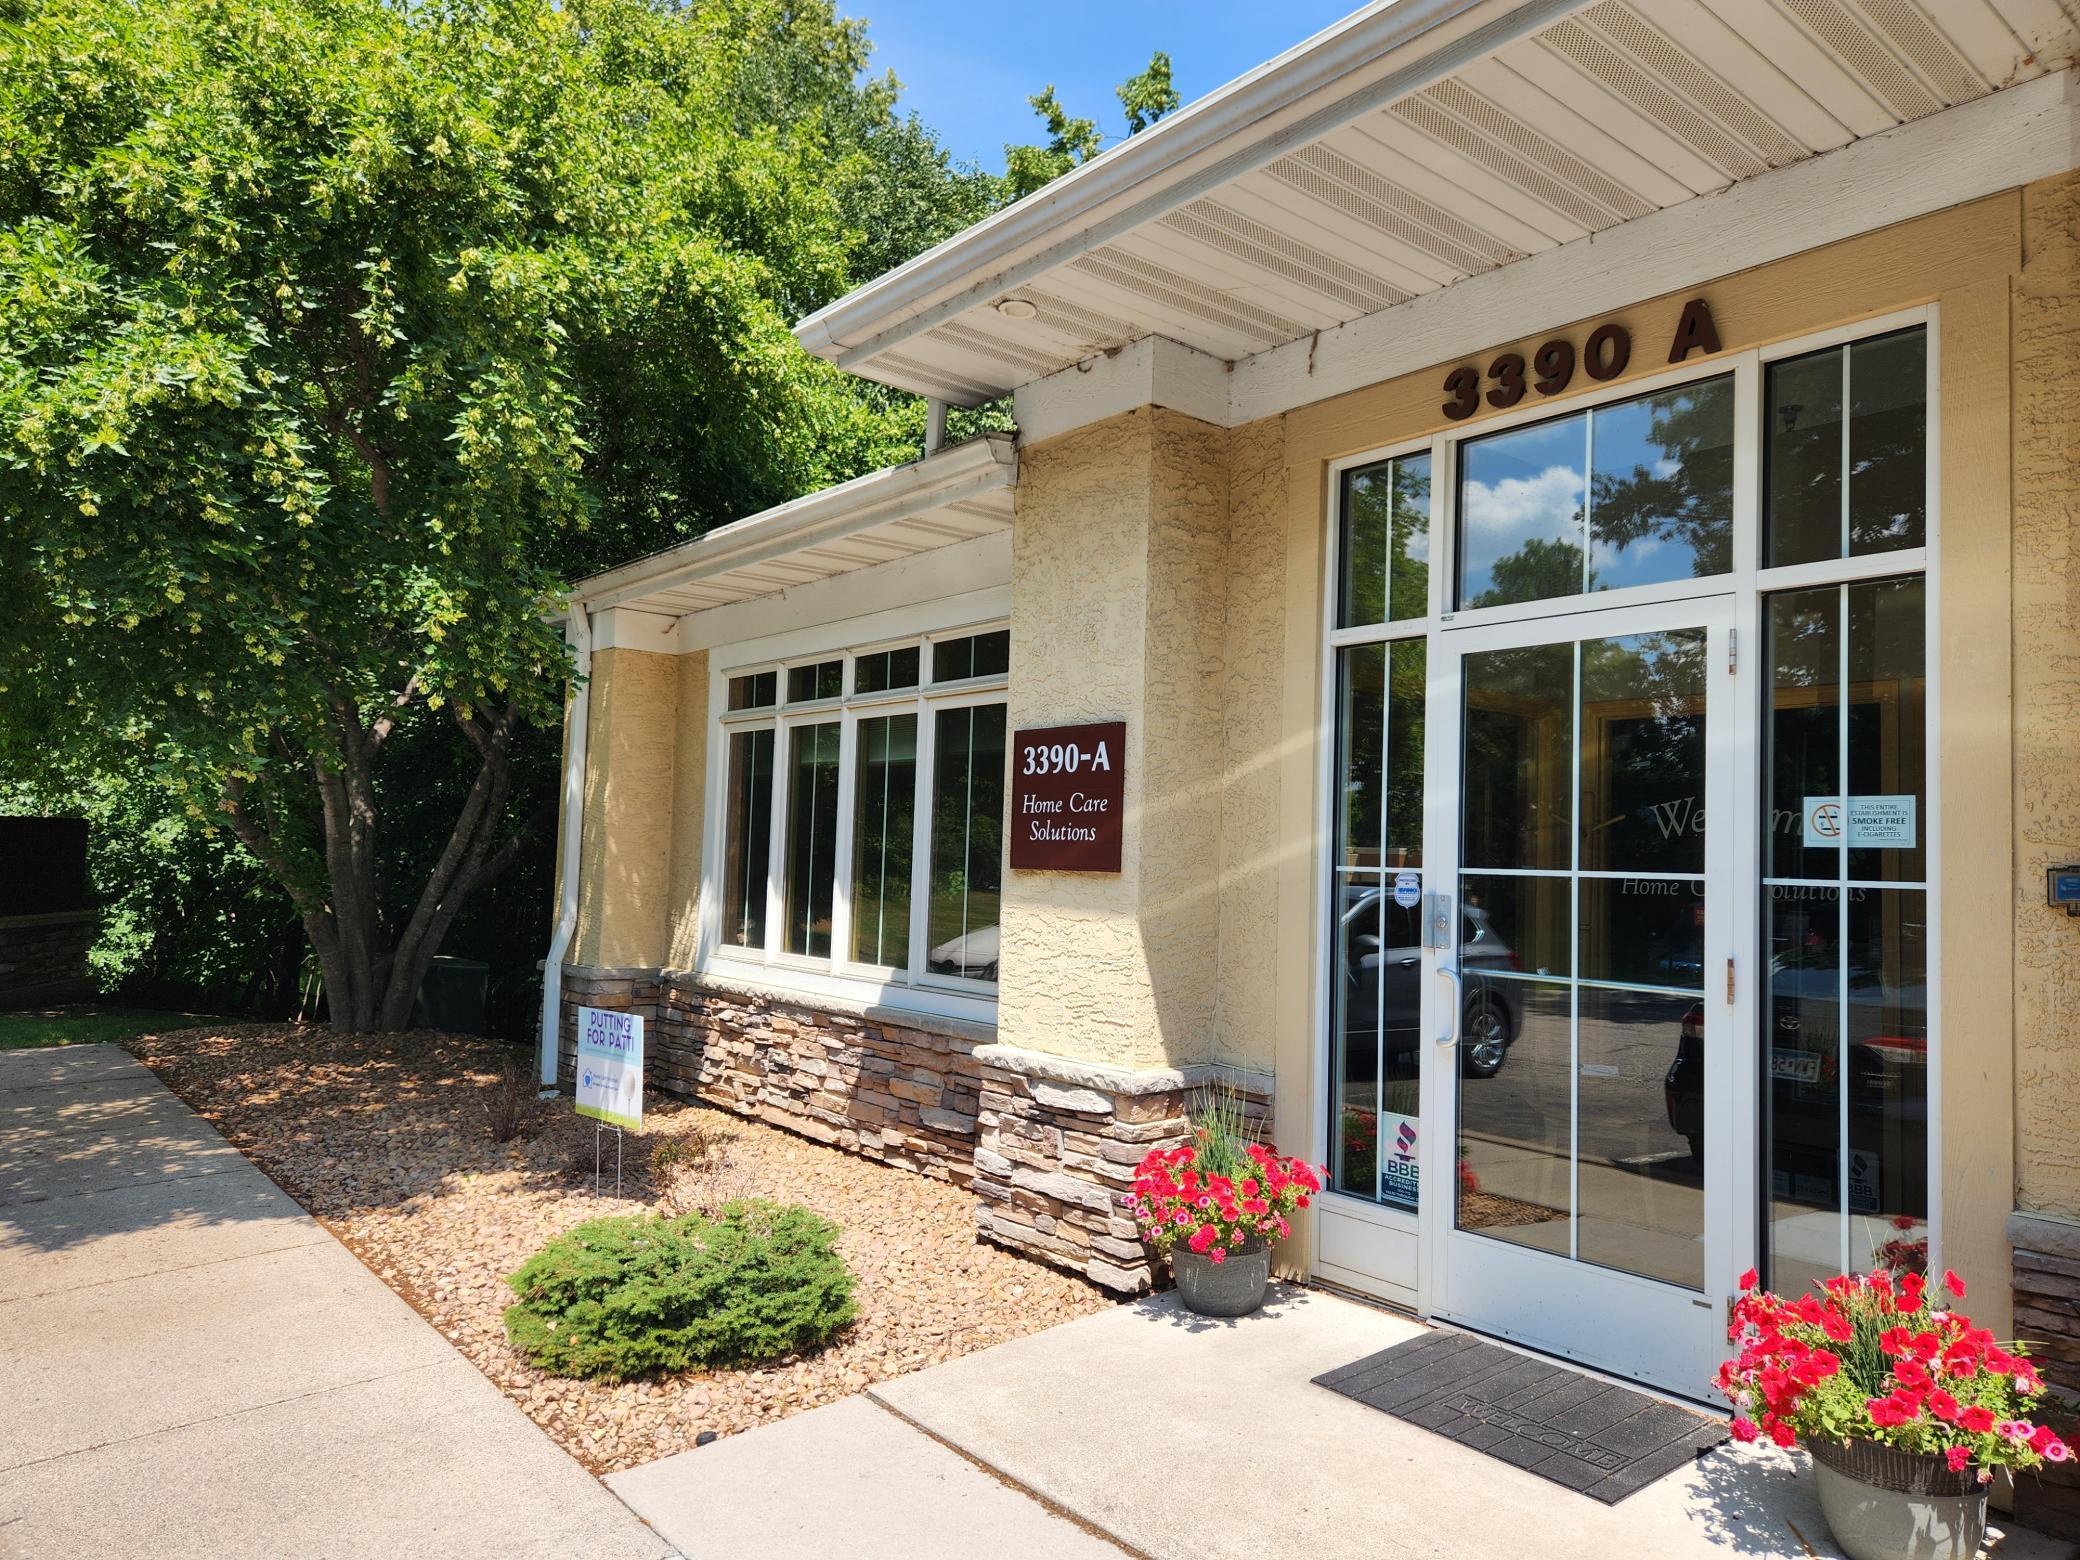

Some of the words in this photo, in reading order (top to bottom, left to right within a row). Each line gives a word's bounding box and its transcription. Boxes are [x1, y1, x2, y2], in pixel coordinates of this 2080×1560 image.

[1441, 323, 1631, 421] 3390
[1668, 298, 1722, 363] A
[1023, 741, 1111, 775] 3390-A
[1022, 794, 1063, 814] Home
[1069, 792, 1108, 813] Care
[1029, 820, 1096, 841] Solutions
[1852, 817, 1884, 825] SMOKE
[1885, 817, 1906, 825] FREE
[1620, 877, 1680, 896] Home
[591, 1011, 632, 1033] PUTTING
[587, 1028, 605, 1046] FOR
[609, 1032, 634, 1053] PATTI
[1388, 1160, 1419, 1179] BBB
[1385, 1175, 1419, 1187] ACCREDIT
[1459, 1399, 1621, 1466] WELCOME
